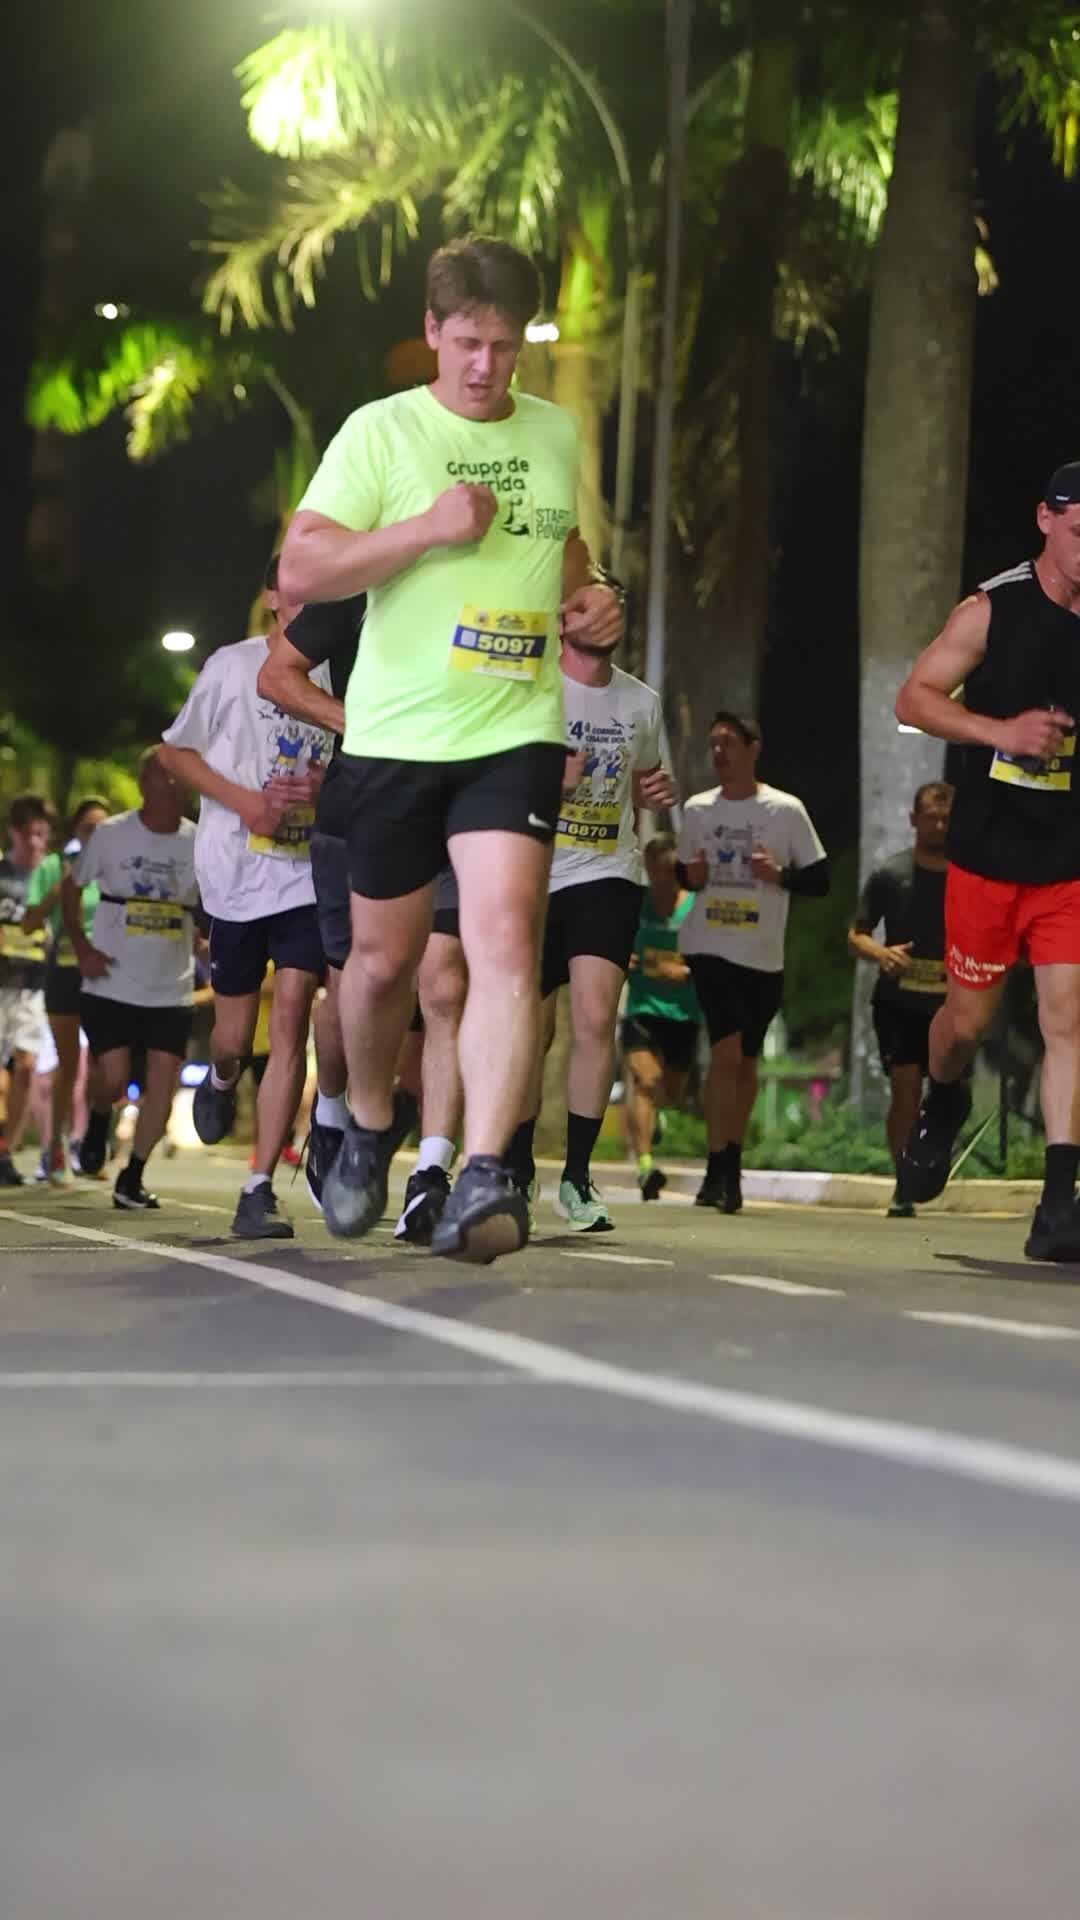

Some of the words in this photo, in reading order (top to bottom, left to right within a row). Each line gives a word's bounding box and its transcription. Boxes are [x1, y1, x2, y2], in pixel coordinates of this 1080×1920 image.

[447, 461, 503, 477] Grupo
[507, 457, 529, 472] de
[477, 633, 536, 655] 5097
[567, 823, 608, 838] 6870
